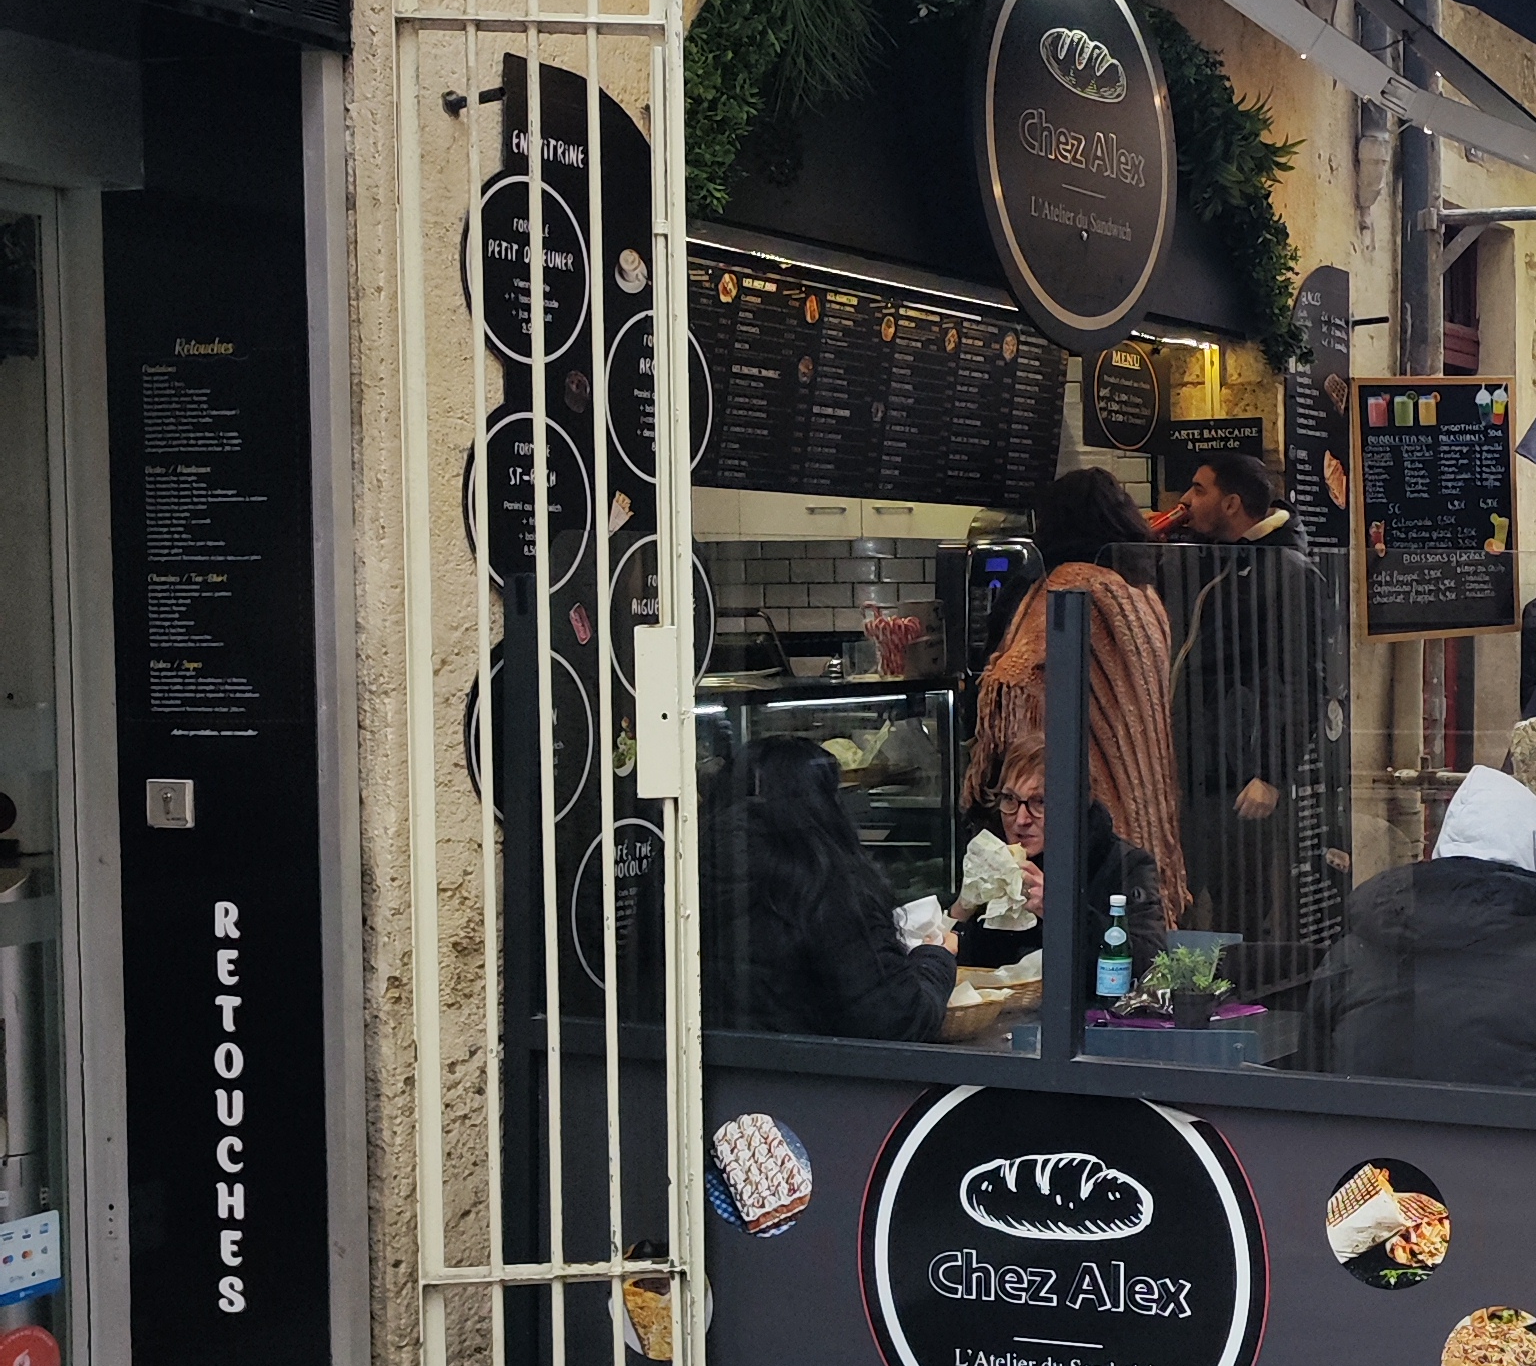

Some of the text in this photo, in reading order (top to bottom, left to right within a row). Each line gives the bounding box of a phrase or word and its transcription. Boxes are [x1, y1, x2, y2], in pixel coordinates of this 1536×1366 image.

[1018, 108, 1146, 189] Chez Alex
[1030, 195, 1132, 242] L'Atelier du Sandwich
[174, 336, 235, 357] Retouches
[1112, 350, 1141, 367] MENU
[1195, 439, 1225, 453] partir
[1227, 438, 1240, 448] de
[1203, 427, 1259, 439] BANCAIRE
[213, 900, 248, 1314] RETOUCHES
[928, 1248, 1192, 1320] Chez Alex
